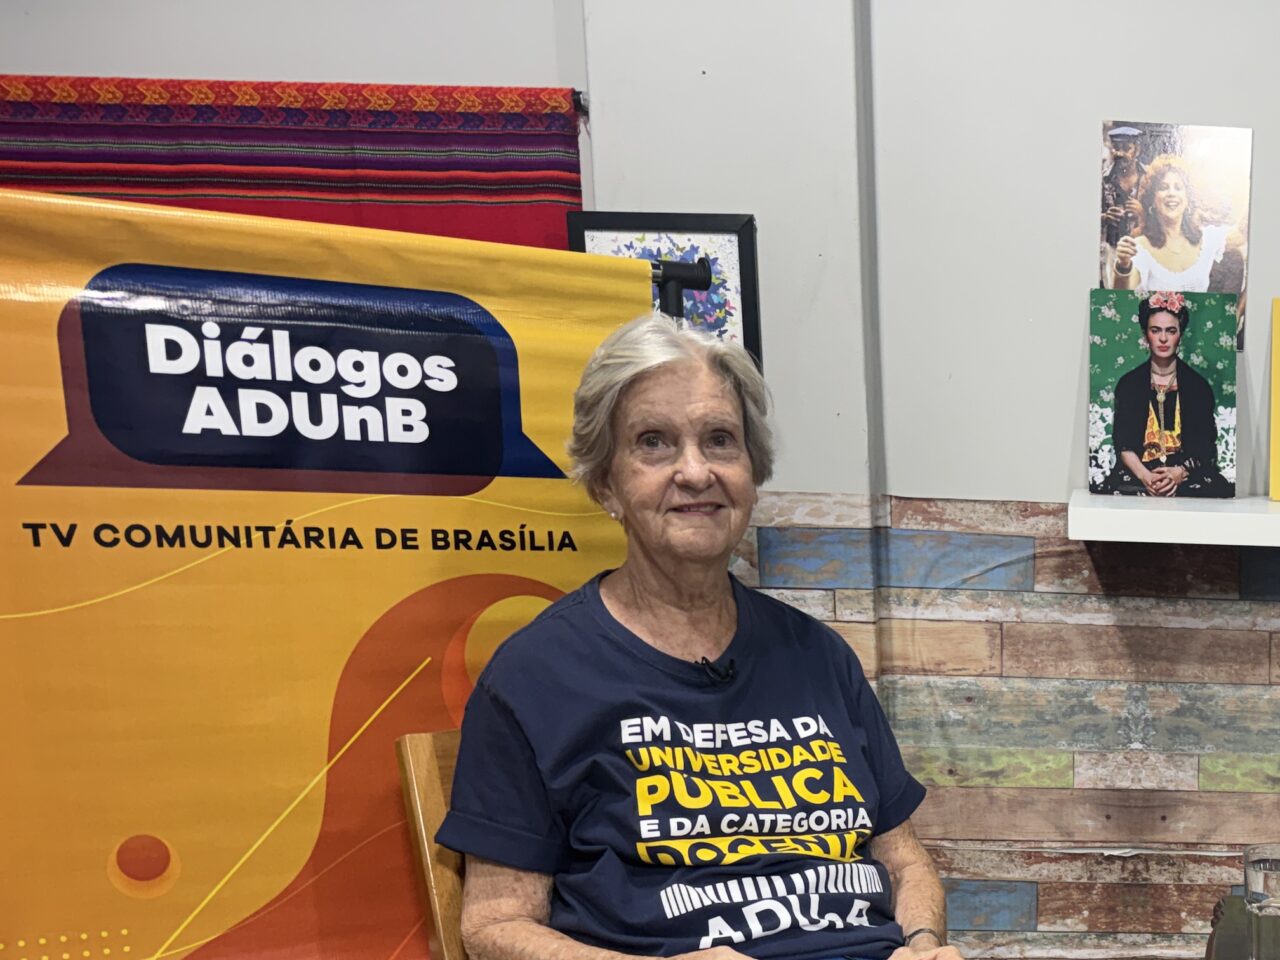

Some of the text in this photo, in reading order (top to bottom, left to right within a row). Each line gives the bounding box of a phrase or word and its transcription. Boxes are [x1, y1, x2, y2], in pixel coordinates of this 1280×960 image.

[145, 321, 458, 399] Diálogos
[181, 386, 430, 443] ADUnB
[22, 516, 577, 552] TV COMUNITÁRIA DE BRASÍLIA
[620, 714, 834, 748] EM DEFESA DA
[626, 739, 847, 776] UNIVERSIDADE
[640, 807, 872, 838] E DA CATEGORIA
